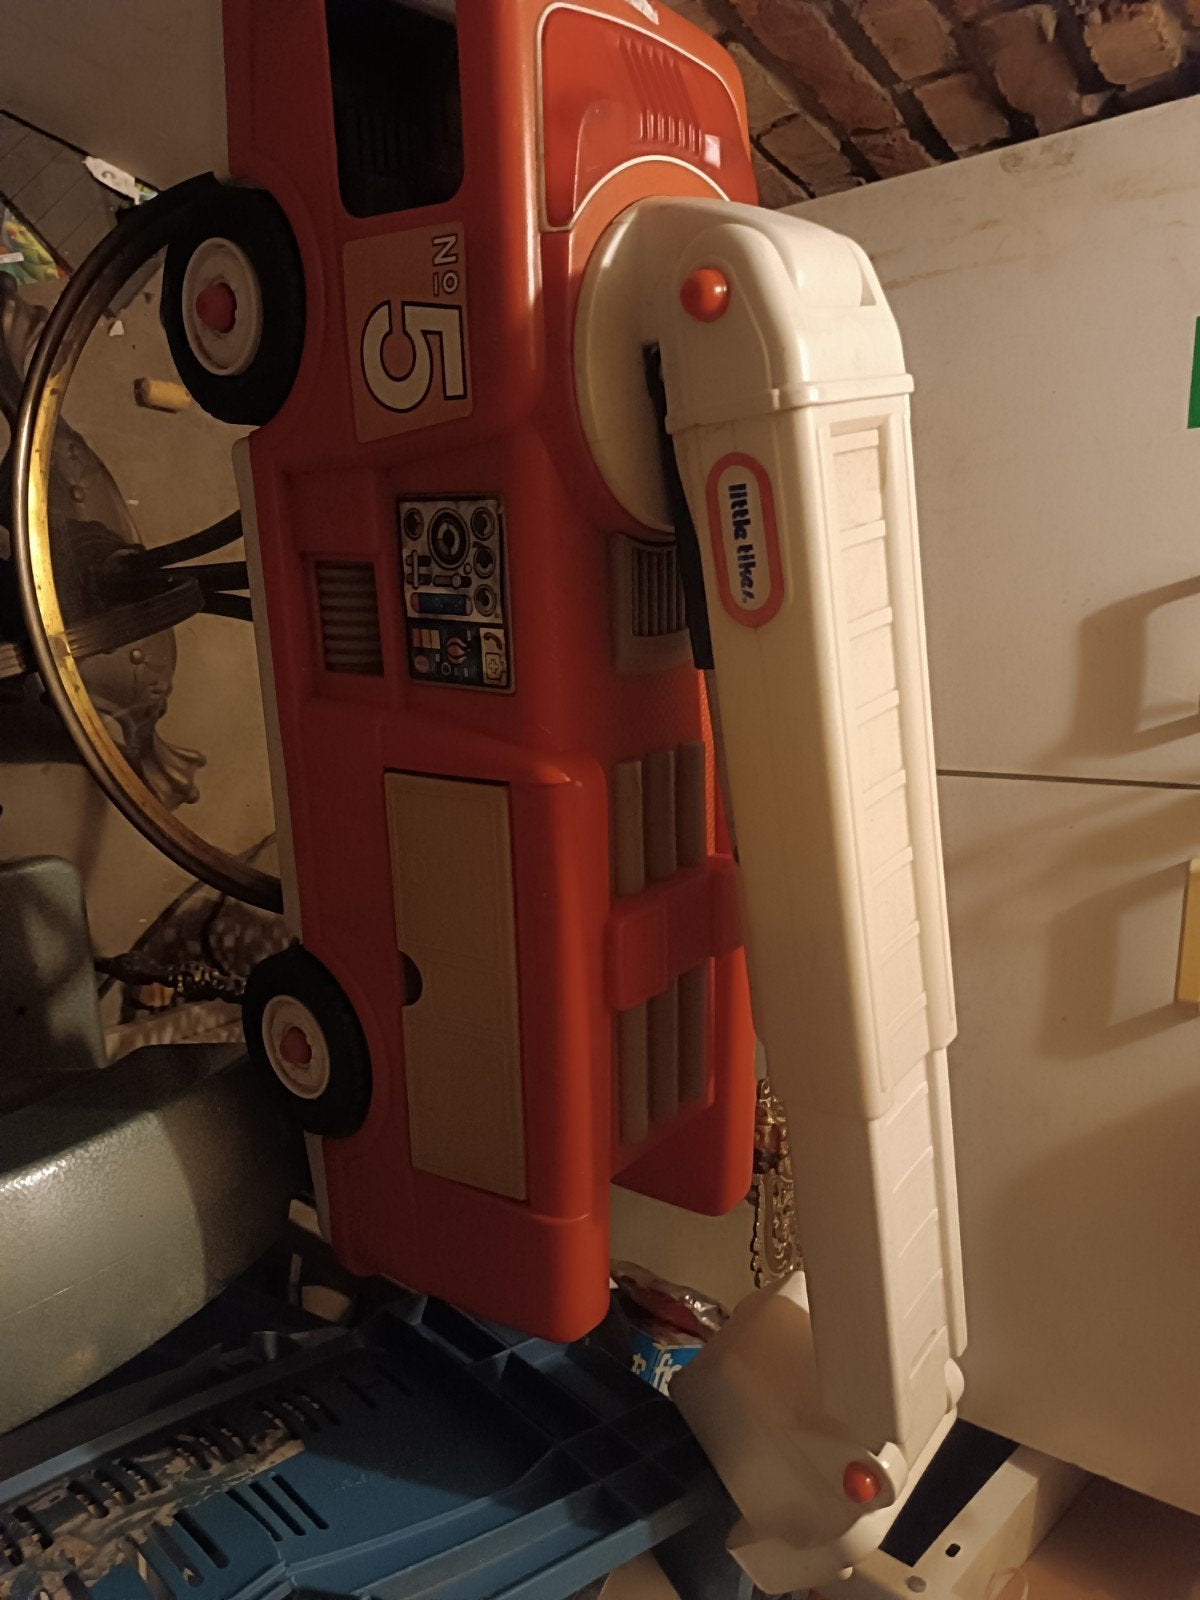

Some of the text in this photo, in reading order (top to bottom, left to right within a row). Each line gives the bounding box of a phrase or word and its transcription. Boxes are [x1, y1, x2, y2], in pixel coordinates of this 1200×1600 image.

[360, 300, 468, 414] 5
[728, 483, 757, 602] little tikes
